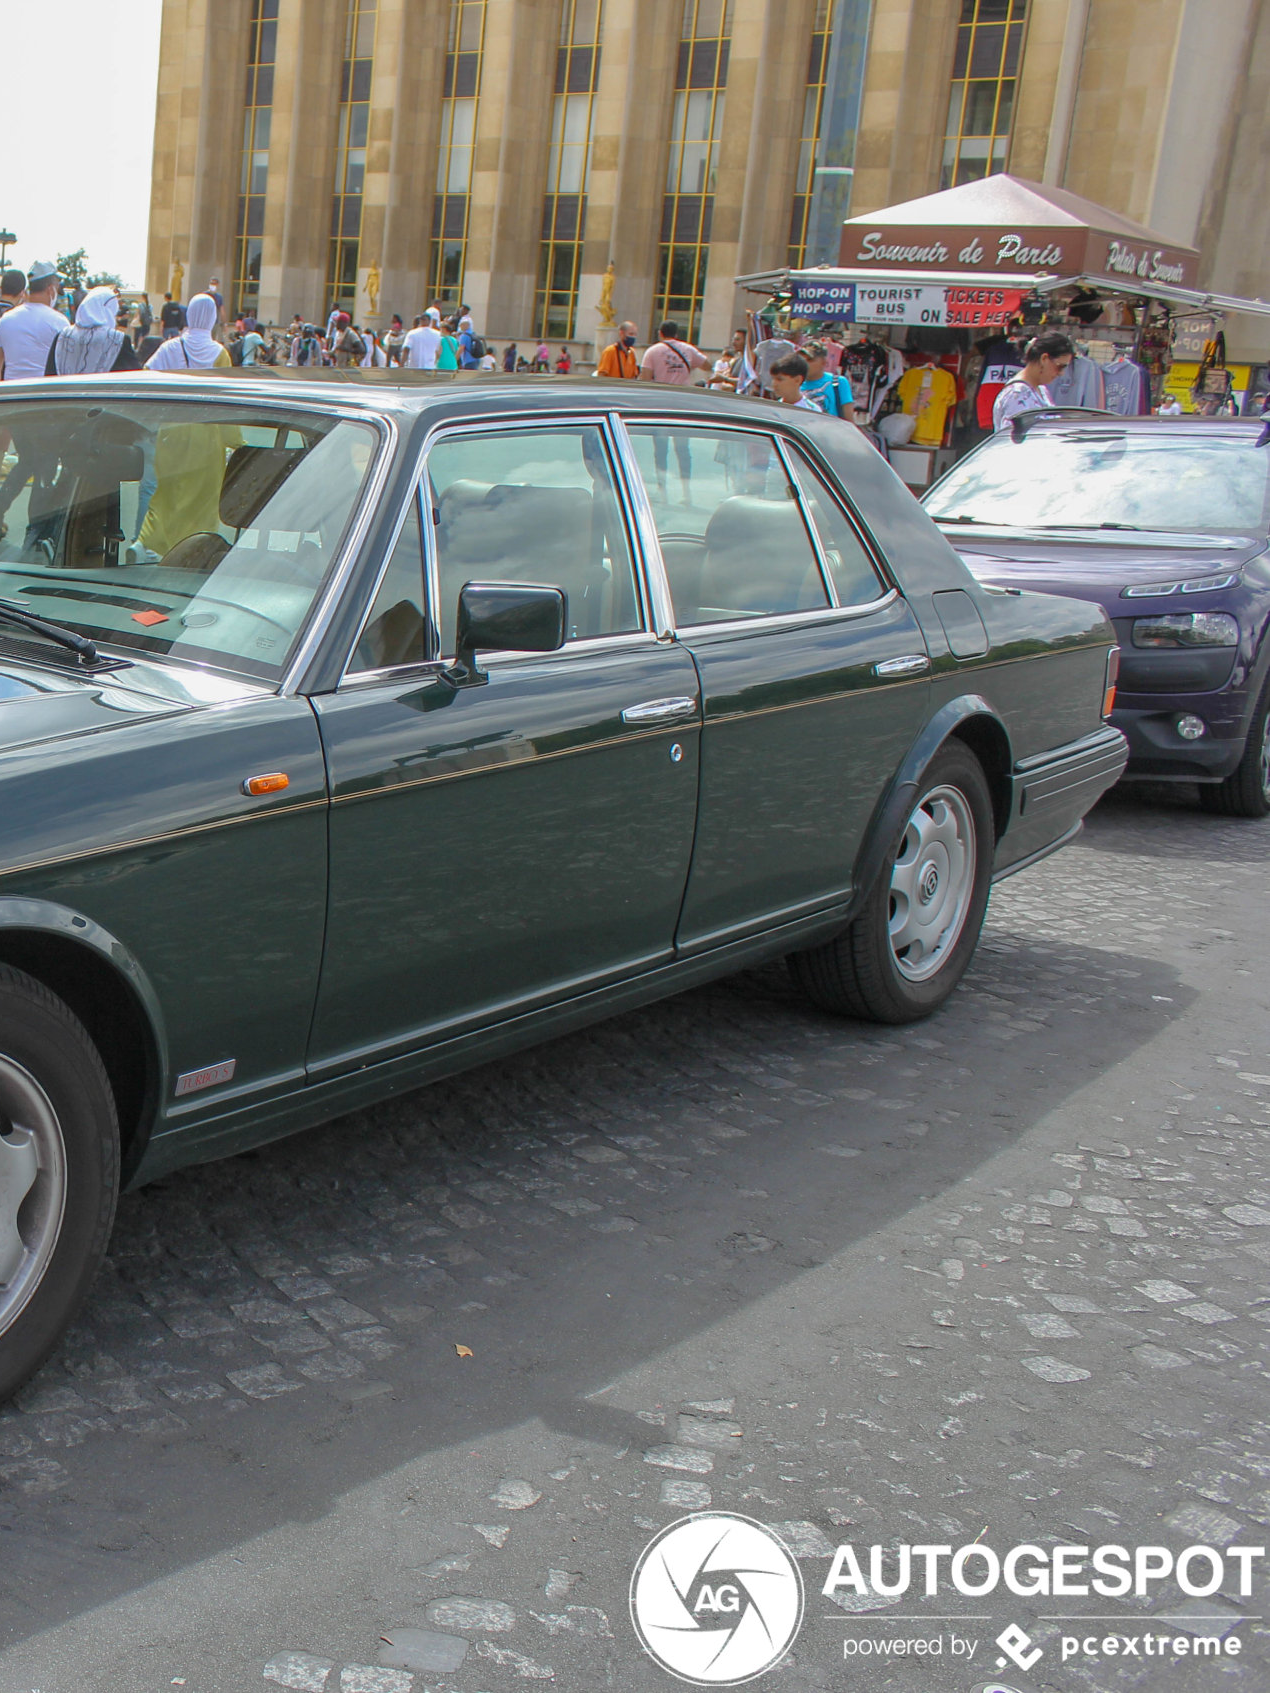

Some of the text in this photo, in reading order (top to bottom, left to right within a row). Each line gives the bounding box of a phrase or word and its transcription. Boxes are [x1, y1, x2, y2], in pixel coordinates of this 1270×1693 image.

[857, 232, 1063, 266] Souvenir de Paris
[859, 288, 1004, 306] TOURIST TICKETS
[876, 303, 905, 314] BUS
[920, 309, 941, 322] ON
[945, 310, 982, 325] SALE
[183, 1065, 230, 1090] TURBO S
